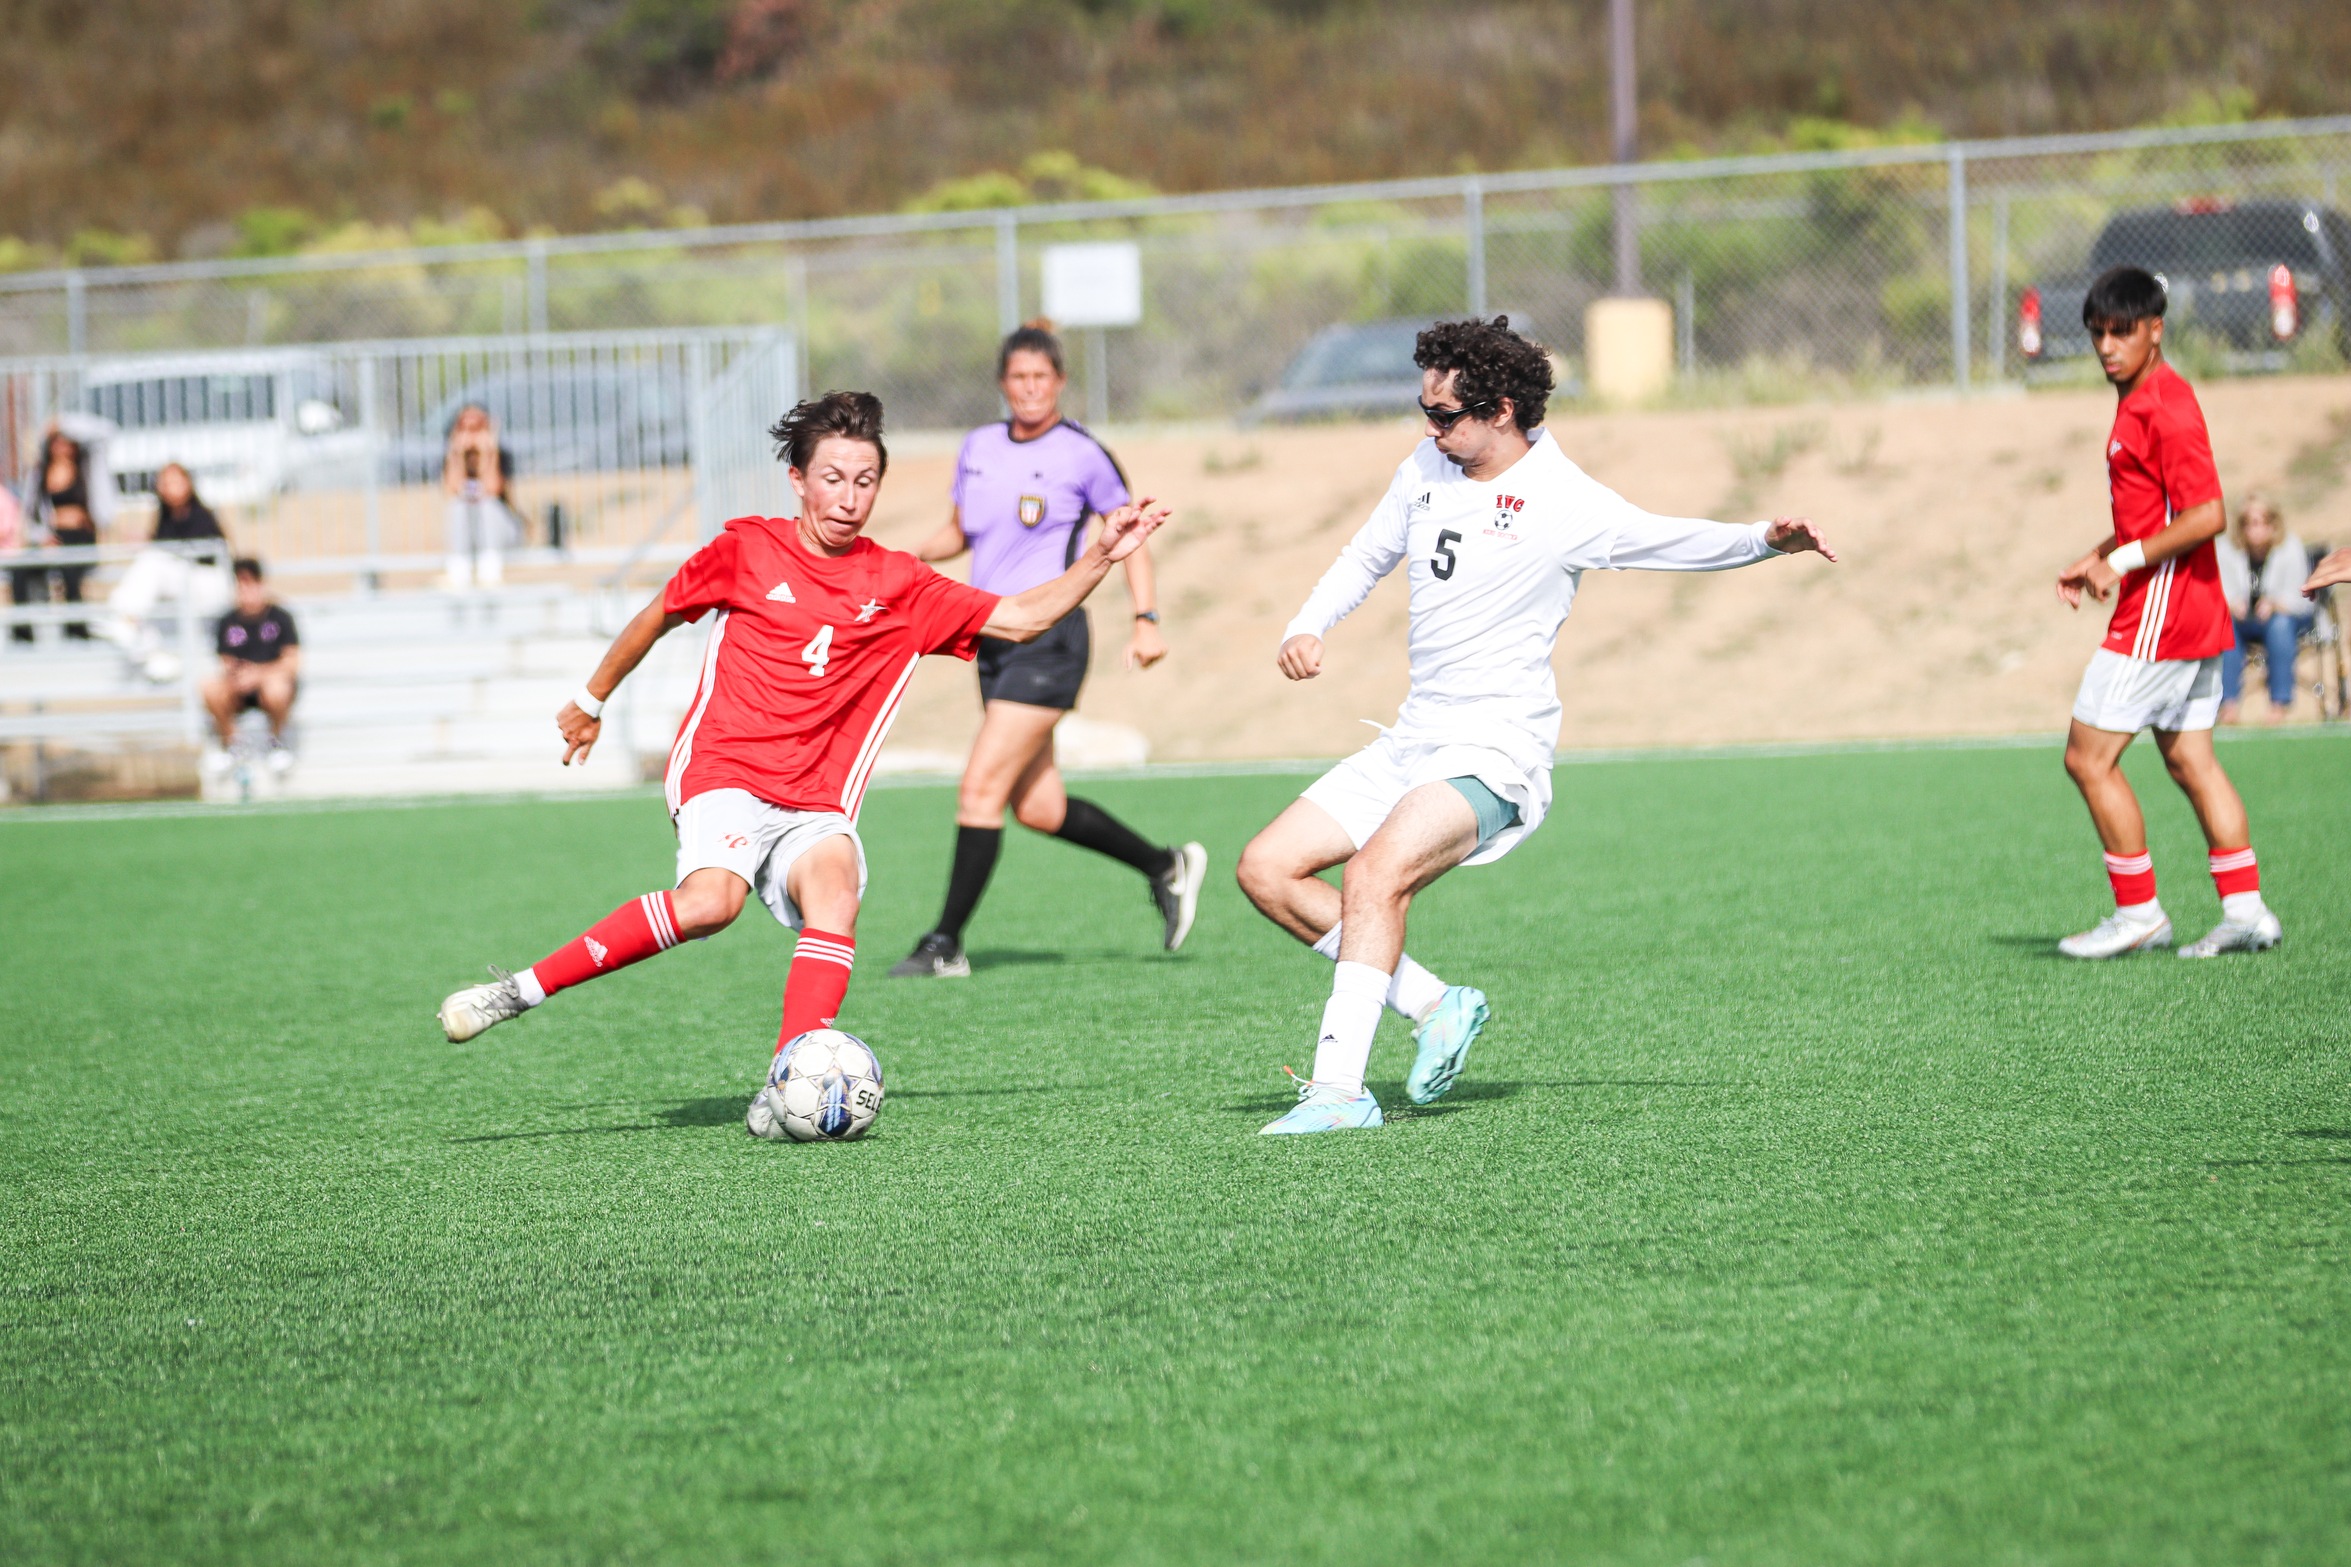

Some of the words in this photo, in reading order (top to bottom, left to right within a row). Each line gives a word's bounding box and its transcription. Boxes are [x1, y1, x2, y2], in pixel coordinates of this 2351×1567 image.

[1496, 494, 1525, 512] IVC
[1431, 528, 1462, 581] 5
[801, 624, 834, 677] 4
